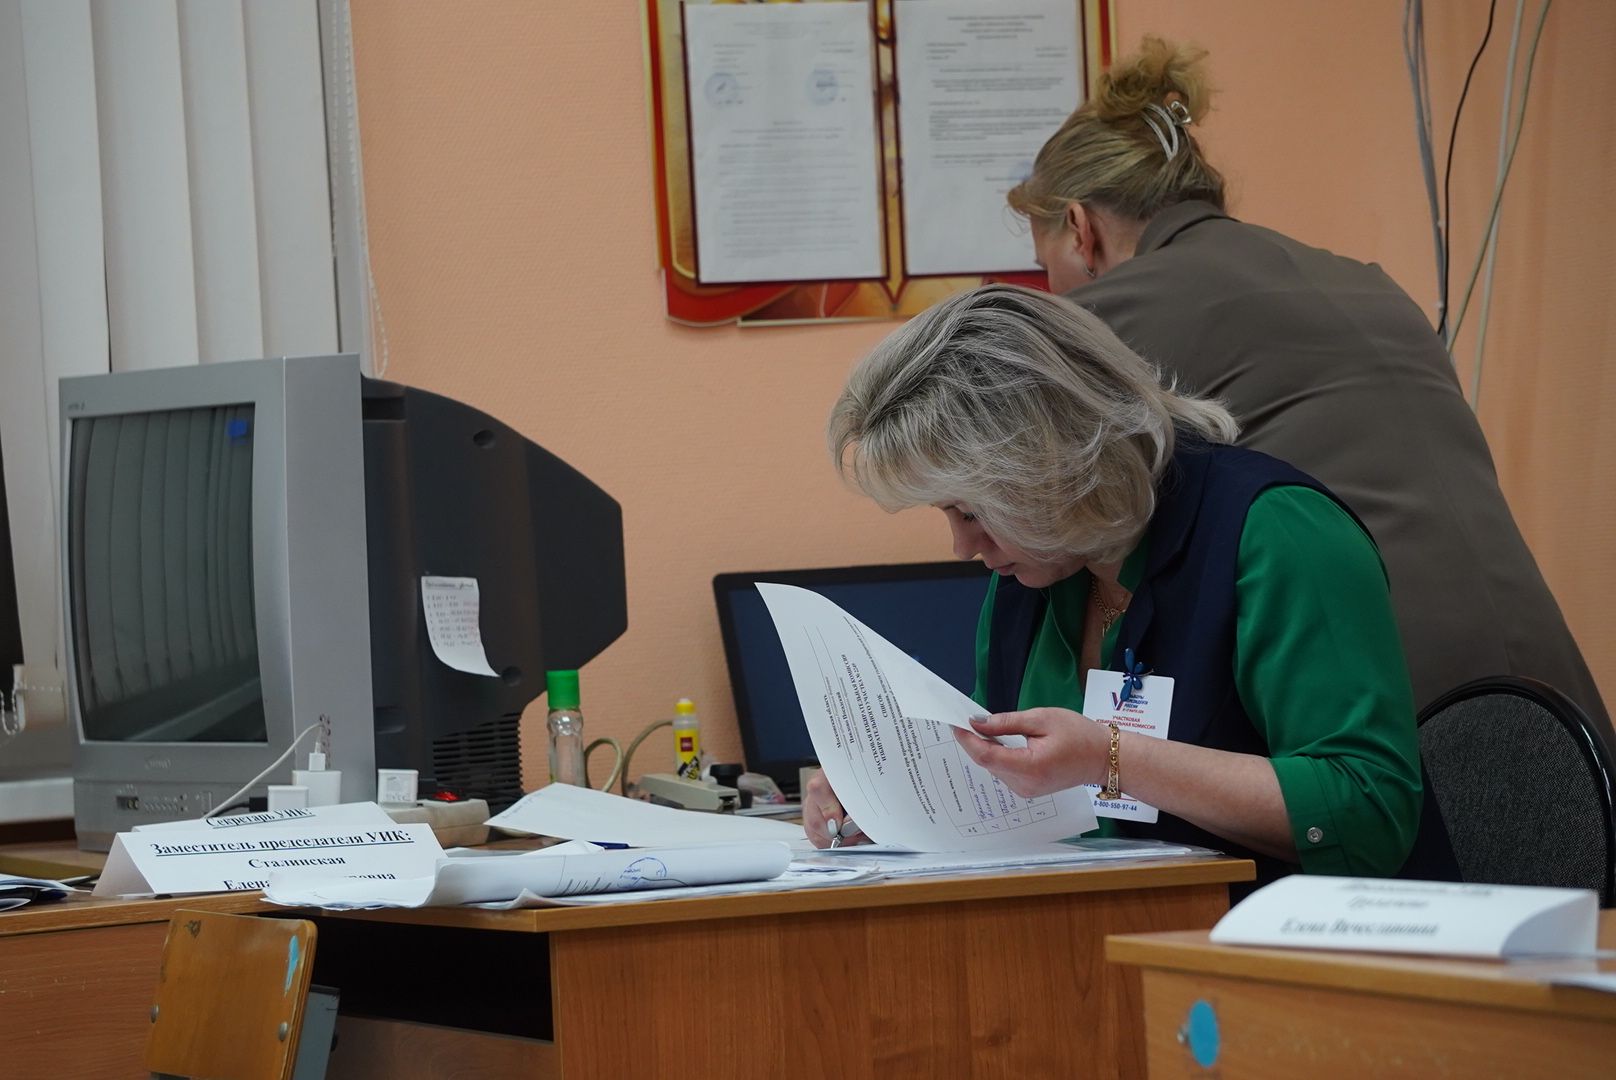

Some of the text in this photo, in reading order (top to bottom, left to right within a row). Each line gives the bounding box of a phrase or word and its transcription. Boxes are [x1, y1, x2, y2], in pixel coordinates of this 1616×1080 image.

[842, 654, 856, 684] КОМИССИЯ
[859, 679, 870, 705] УЧАСТКА
[854, 683, 871, 733] ИЗБИРАТЕЛЬНАЯ
[879, 693, 888, 718] СПИСОК
[867, 705, 886, 762] ИЗБИРАТЕЛЬНОГО
[869, 733, 884, 776] УЧАСТКОВАЯ
[206, 807, 313, 826] Секретарь УИК:
[1094, 800, 1137, 811] 8-800-550-97-44
[150, 830, 412, 855] Заместитель председателя УИК:
[248, 856, 346, 869] Сталинская
